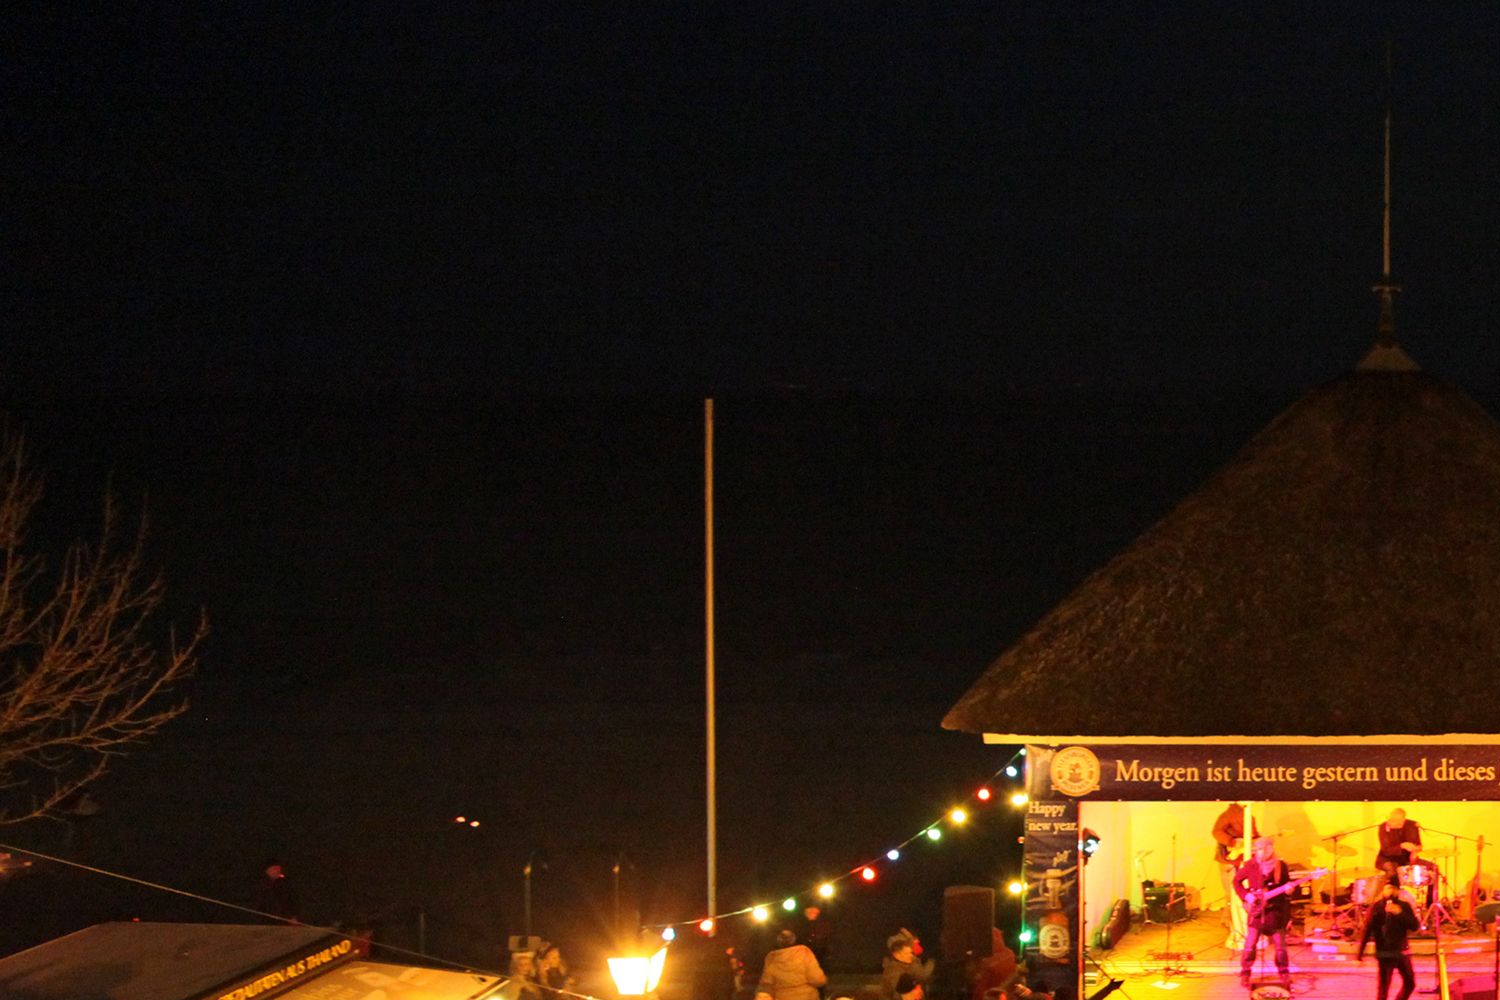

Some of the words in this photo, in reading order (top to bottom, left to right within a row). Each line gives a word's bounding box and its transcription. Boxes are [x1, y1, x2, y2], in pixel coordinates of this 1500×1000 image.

[1115, 760, 1200, 789] Morgen
[1207, 760, 1232, 782] ist
[1237, 759, 1297, 782] heute
[1303, 763, 1380, 789] gestern
[1385, 759, 1427, 782] und
[1434, 759, 1495, 782] dieses
[1028, 801, 1066, 817] Happy
[1028, 822, 1052, 831] new
